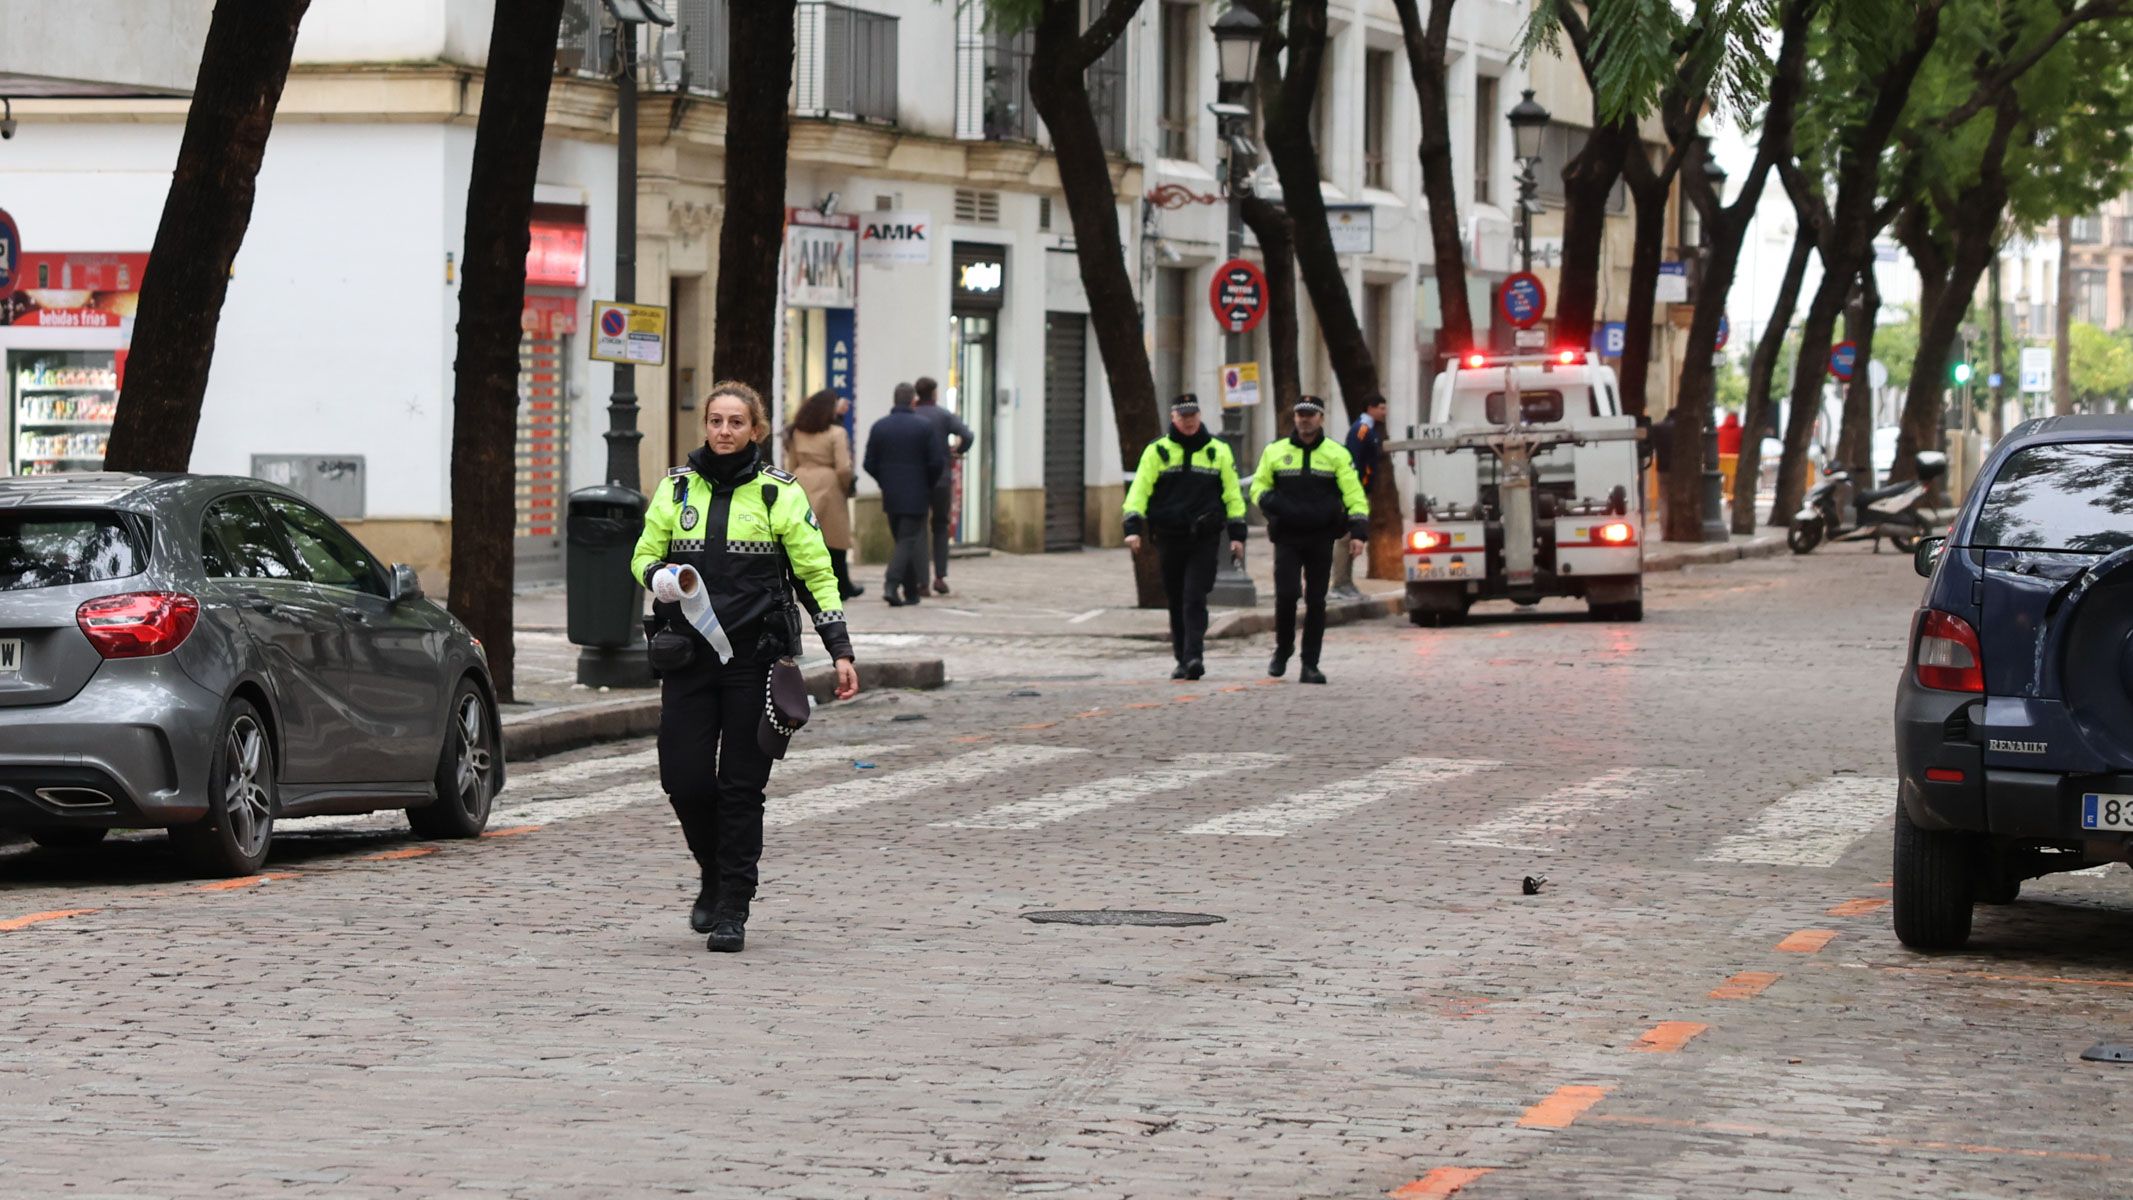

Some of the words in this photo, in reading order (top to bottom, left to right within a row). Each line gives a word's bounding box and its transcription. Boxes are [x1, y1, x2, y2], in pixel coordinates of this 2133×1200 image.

[863, 224, 925, 240] AMK
[796, 240, 844, 288] AMK
[39, 309, 79, 326] bebidas
[1607, 328, 1625, 351] B
[1423, 427, 1443, 440] K13
[2, 643, 15, 667] W
[1989, 739, 2048, 753] RENAULT
